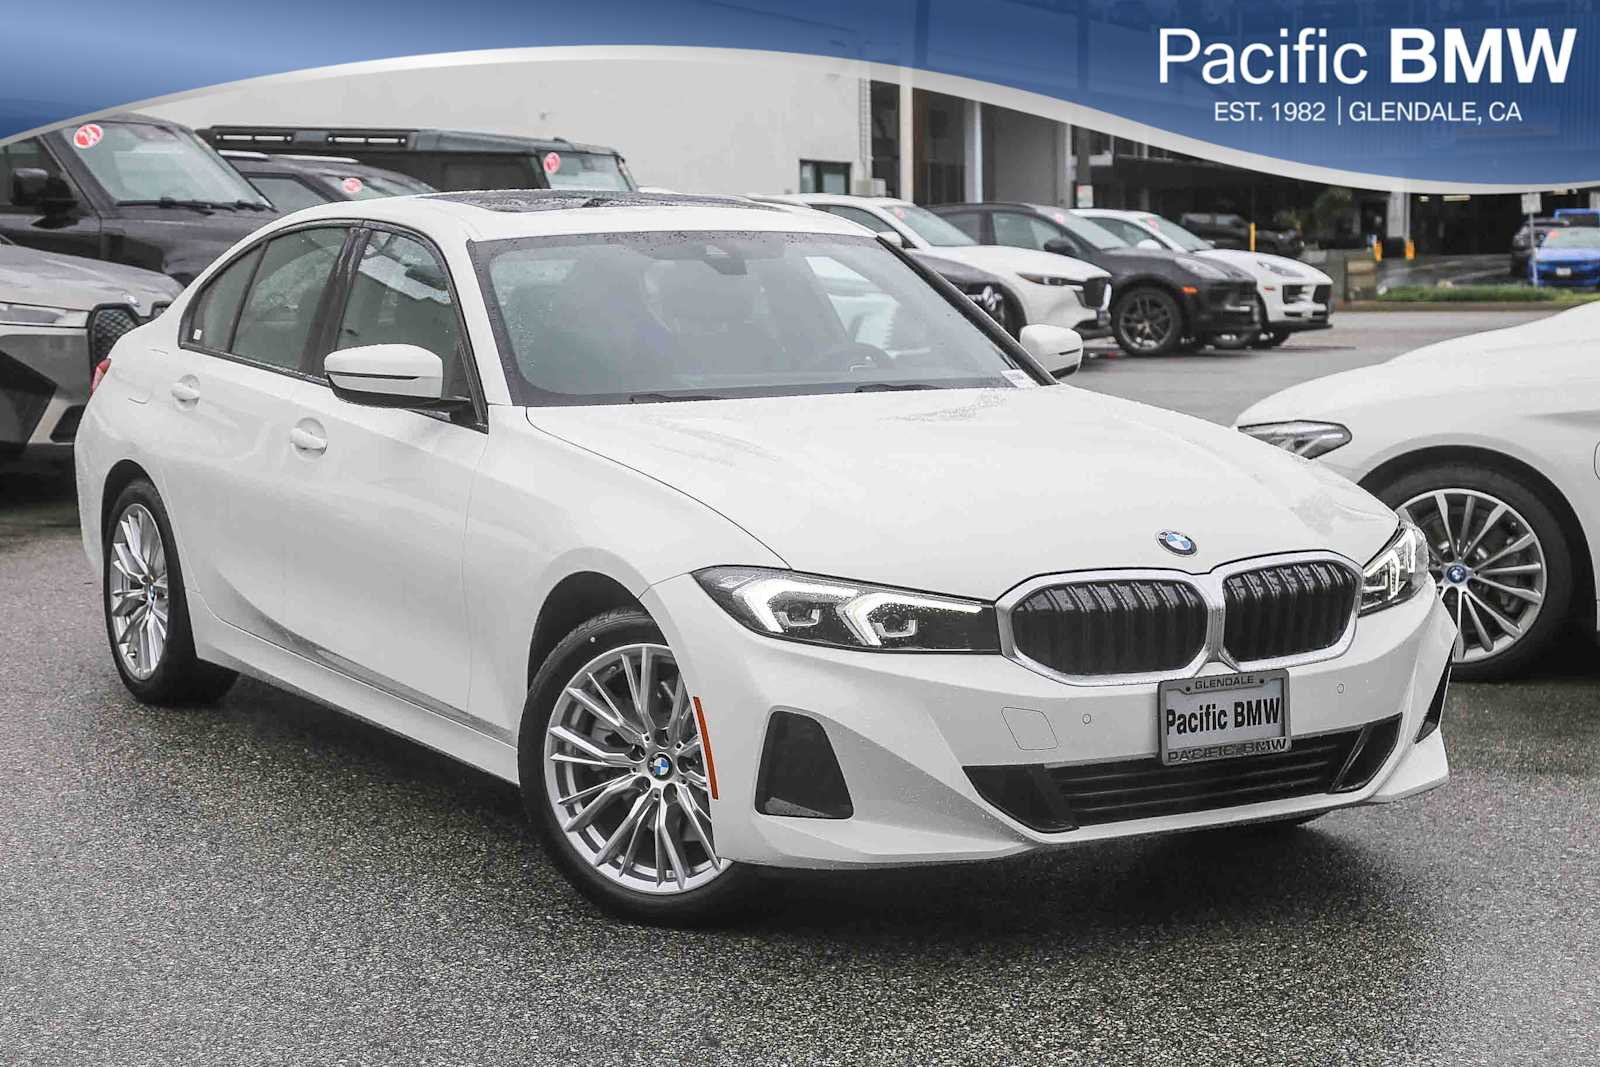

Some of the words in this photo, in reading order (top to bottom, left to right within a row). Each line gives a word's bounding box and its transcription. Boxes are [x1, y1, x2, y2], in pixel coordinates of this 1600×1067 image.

[1195, 675, 1254, 690] GLENDALE
[1167, 704, 1228, 735] Pacific
[1234, 697, 1281, 728] BMW
[1243, 738, 1287, 754] BMW
